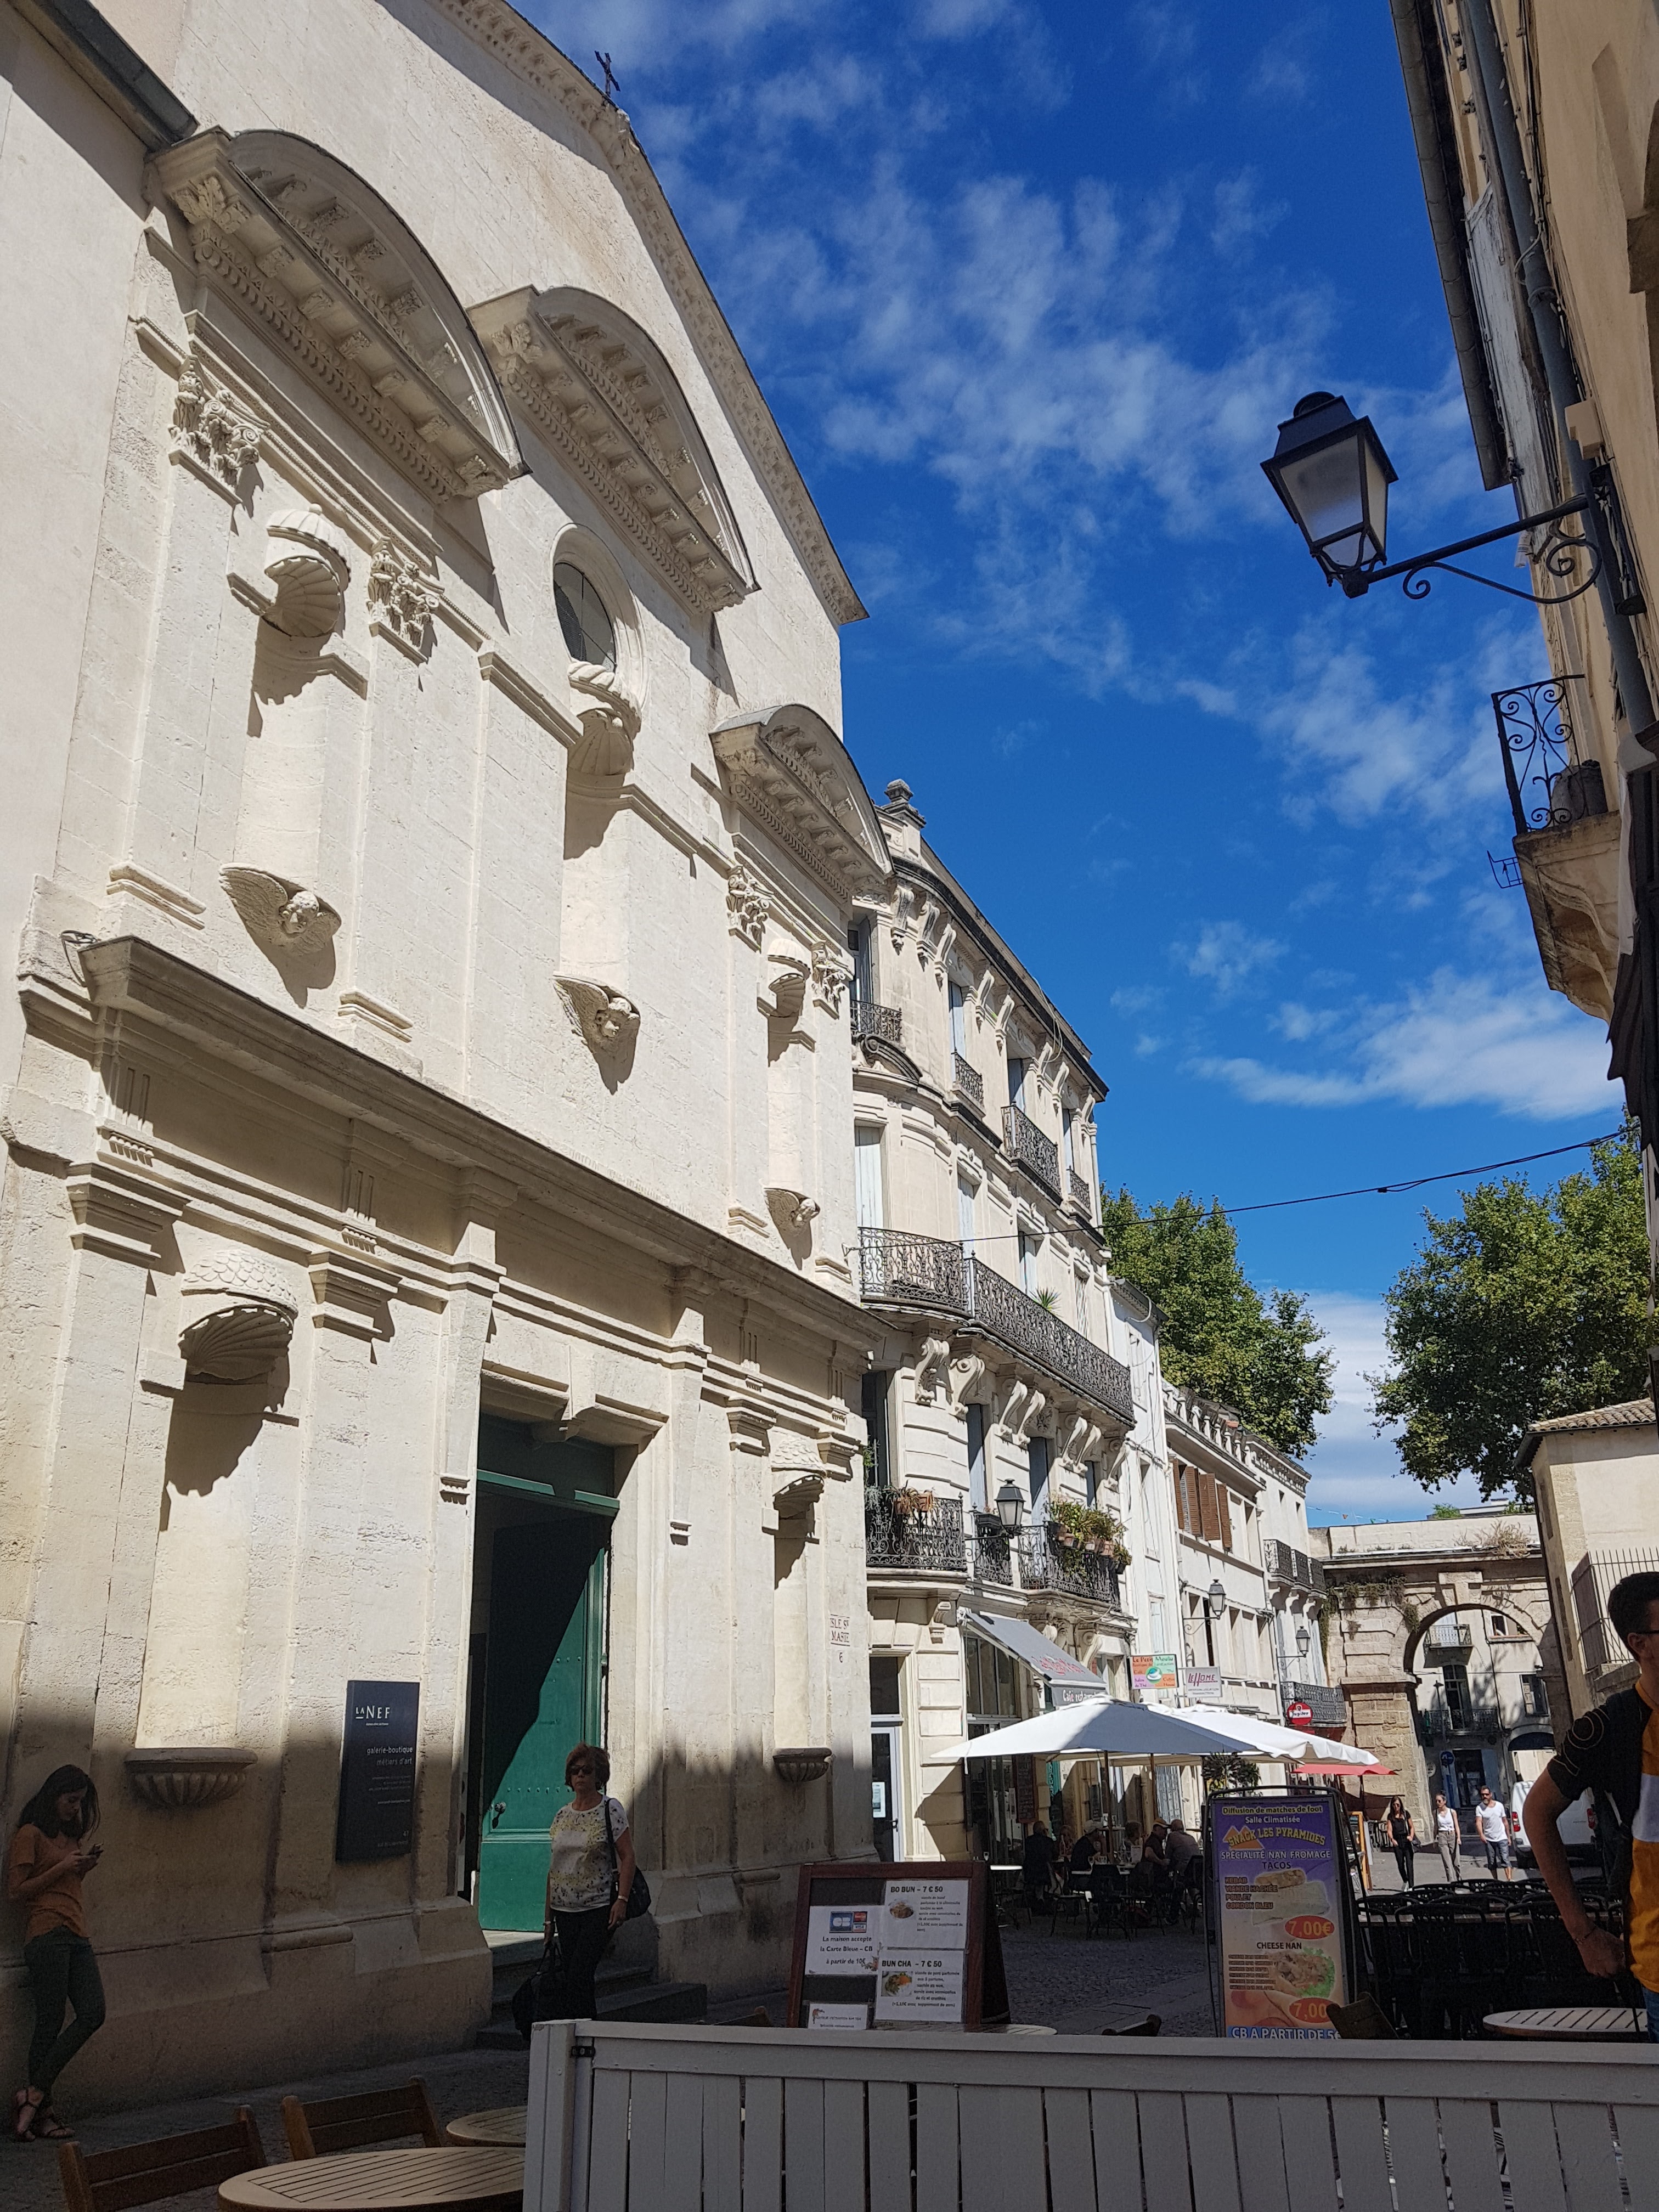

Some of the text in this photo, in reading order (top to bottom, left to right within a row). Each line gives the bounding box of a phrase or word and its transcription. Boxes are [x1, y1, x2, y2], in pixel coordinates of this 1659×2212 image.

[366, 1705, 390, 1719] NEF
[366, 1746, 413, 1756] galerie-boutique
[1228, 1827, 1325, 1847] SNACK LES PYRAMIDES
[1221, 1850, 1265, 1859] SPÉCIALITÉ
[1289, 1921, 1331, 1937] 7,00€
[1294, 2003, 1327, 2020] 7,00
[1232, 2027, 1248, 2039] CB
[1262, 2028, 1308, 2039] PARTIR
[1308, 2030, 1324, 2039] DE
